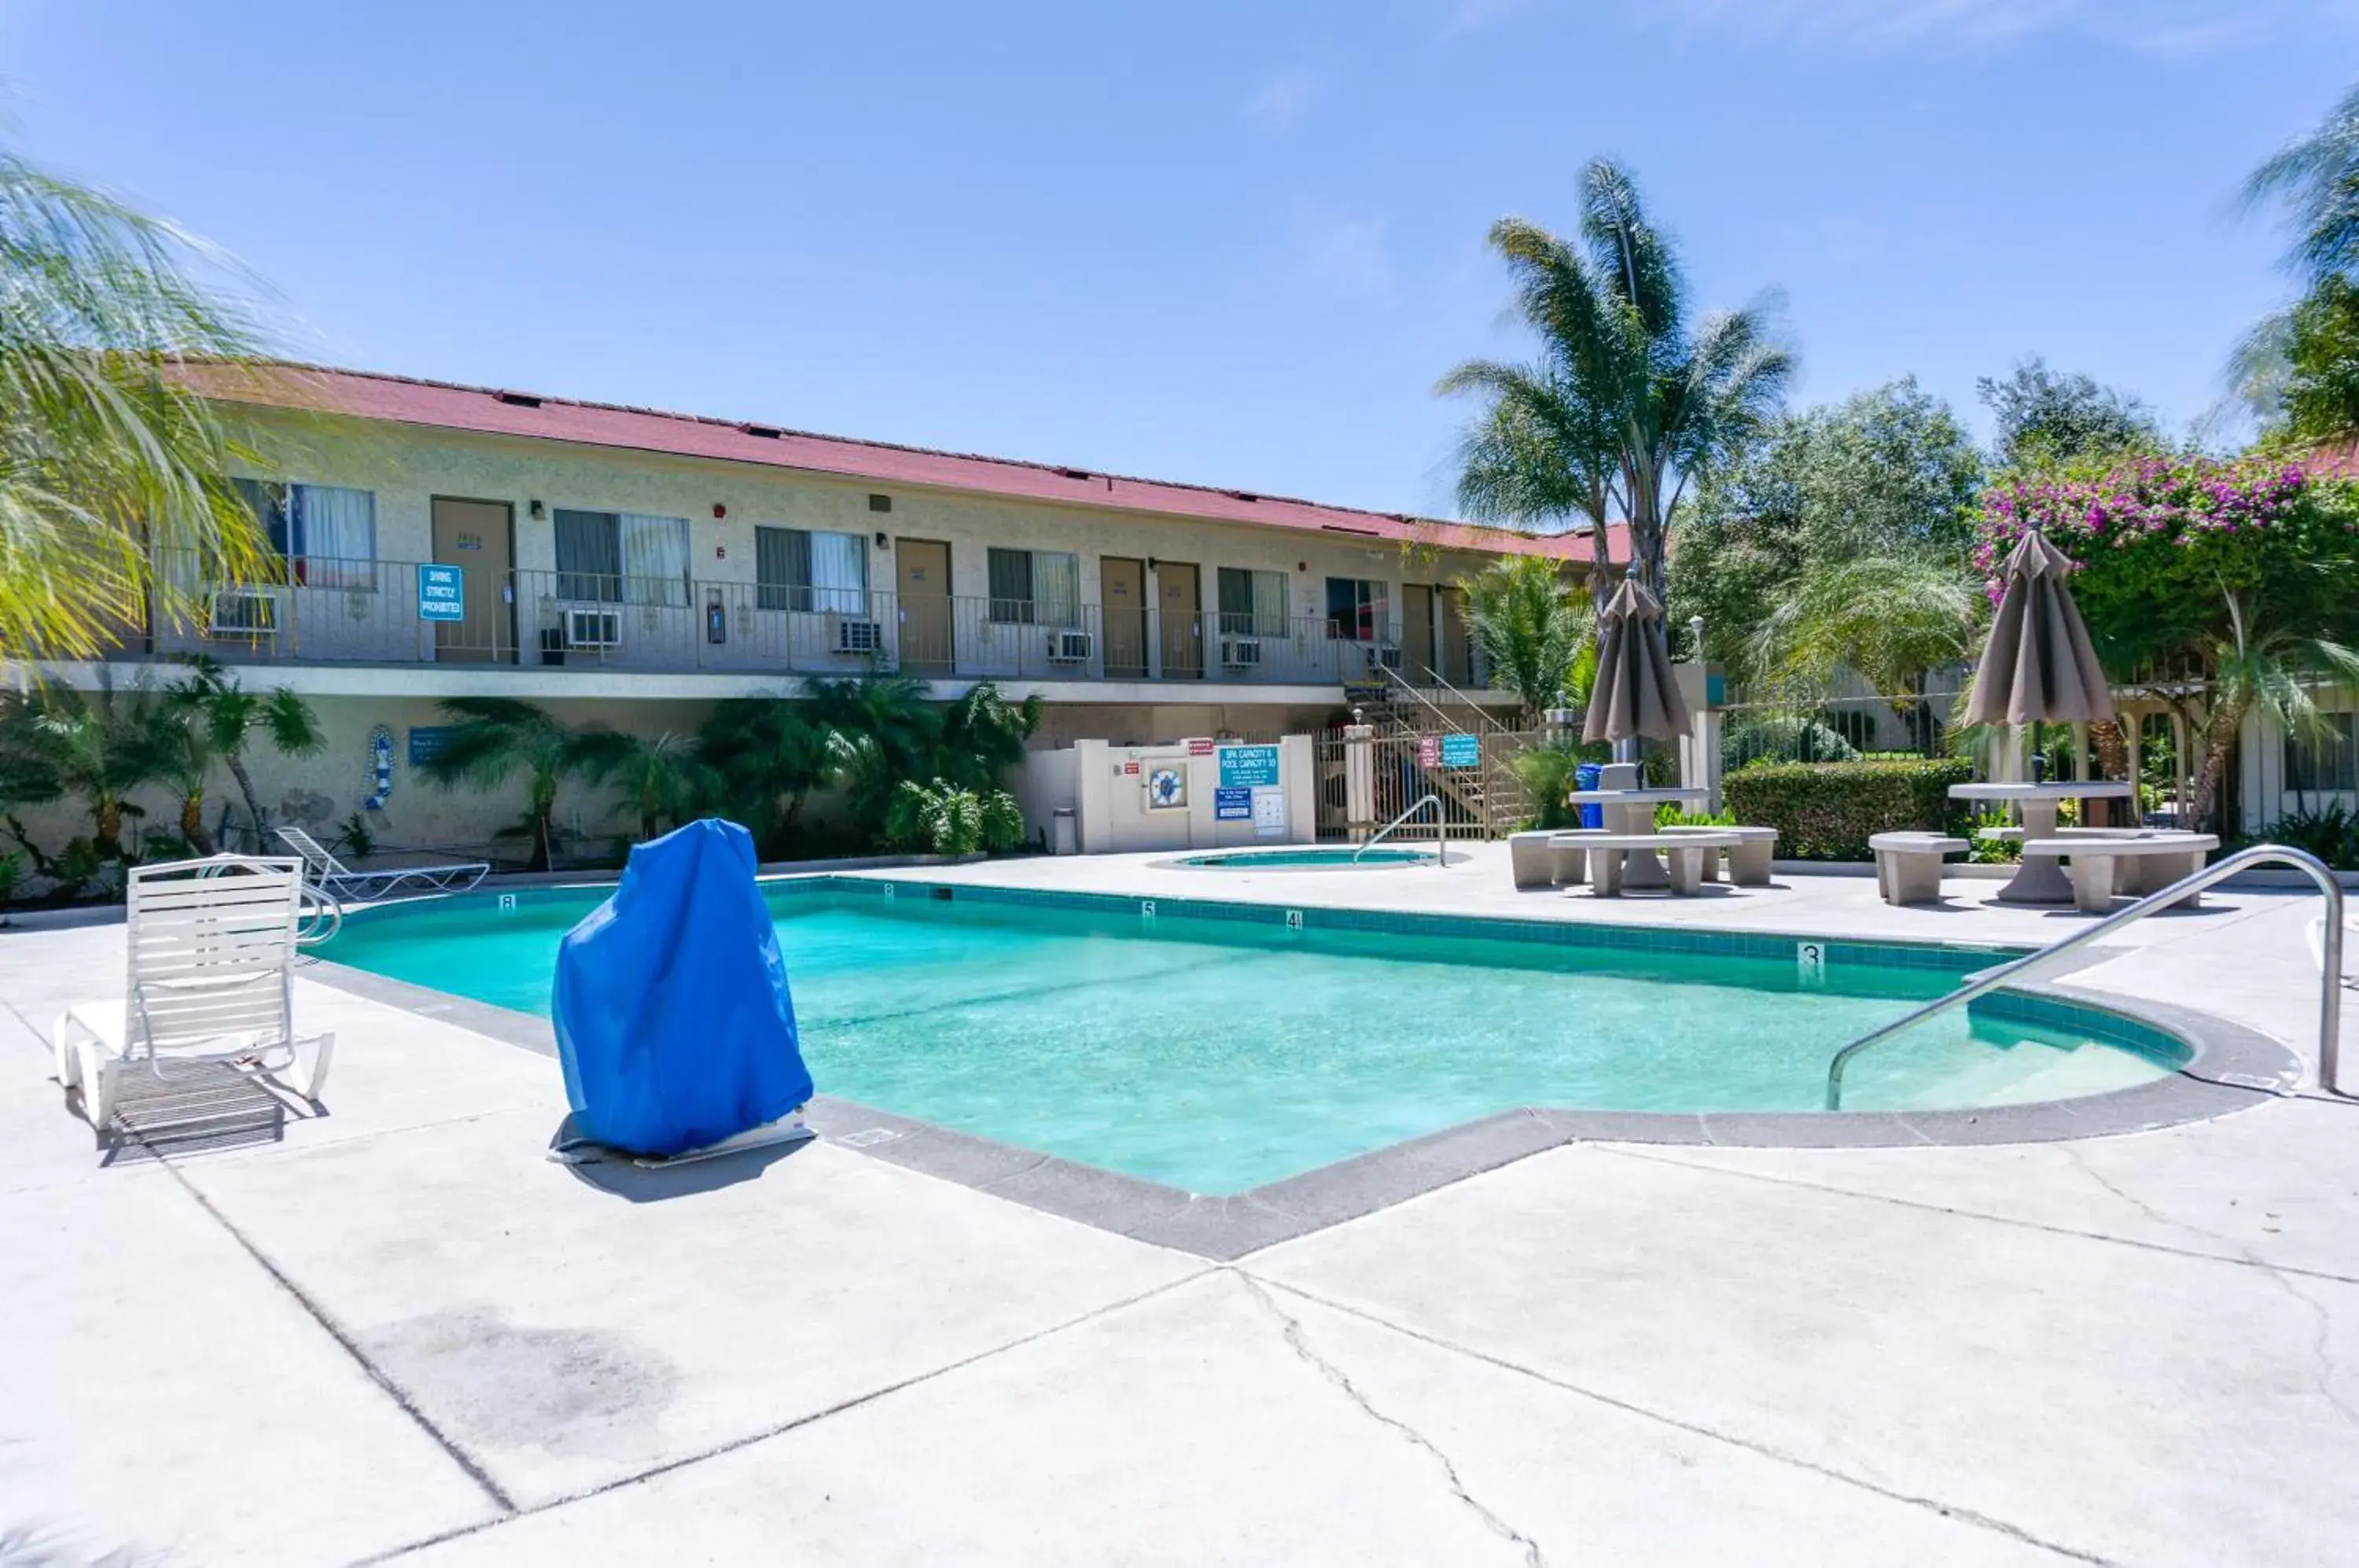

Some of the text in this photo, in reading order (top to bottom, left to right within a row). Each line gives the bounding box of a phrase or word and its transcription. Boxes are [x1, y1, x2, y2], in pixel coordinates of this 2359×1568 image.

[427, 586, 455, 598] STRICTLY
[422, 602, 460, 613] PROHIBITED
[1238, 749, 1266, 759] CAPACITY
[1221, 759, 1238, 768] POOL
[1238, 758, 1267, 768] CAPACITY
[502, 896, 512, 907] 8
[1804, 945, 1819, 963] 3
